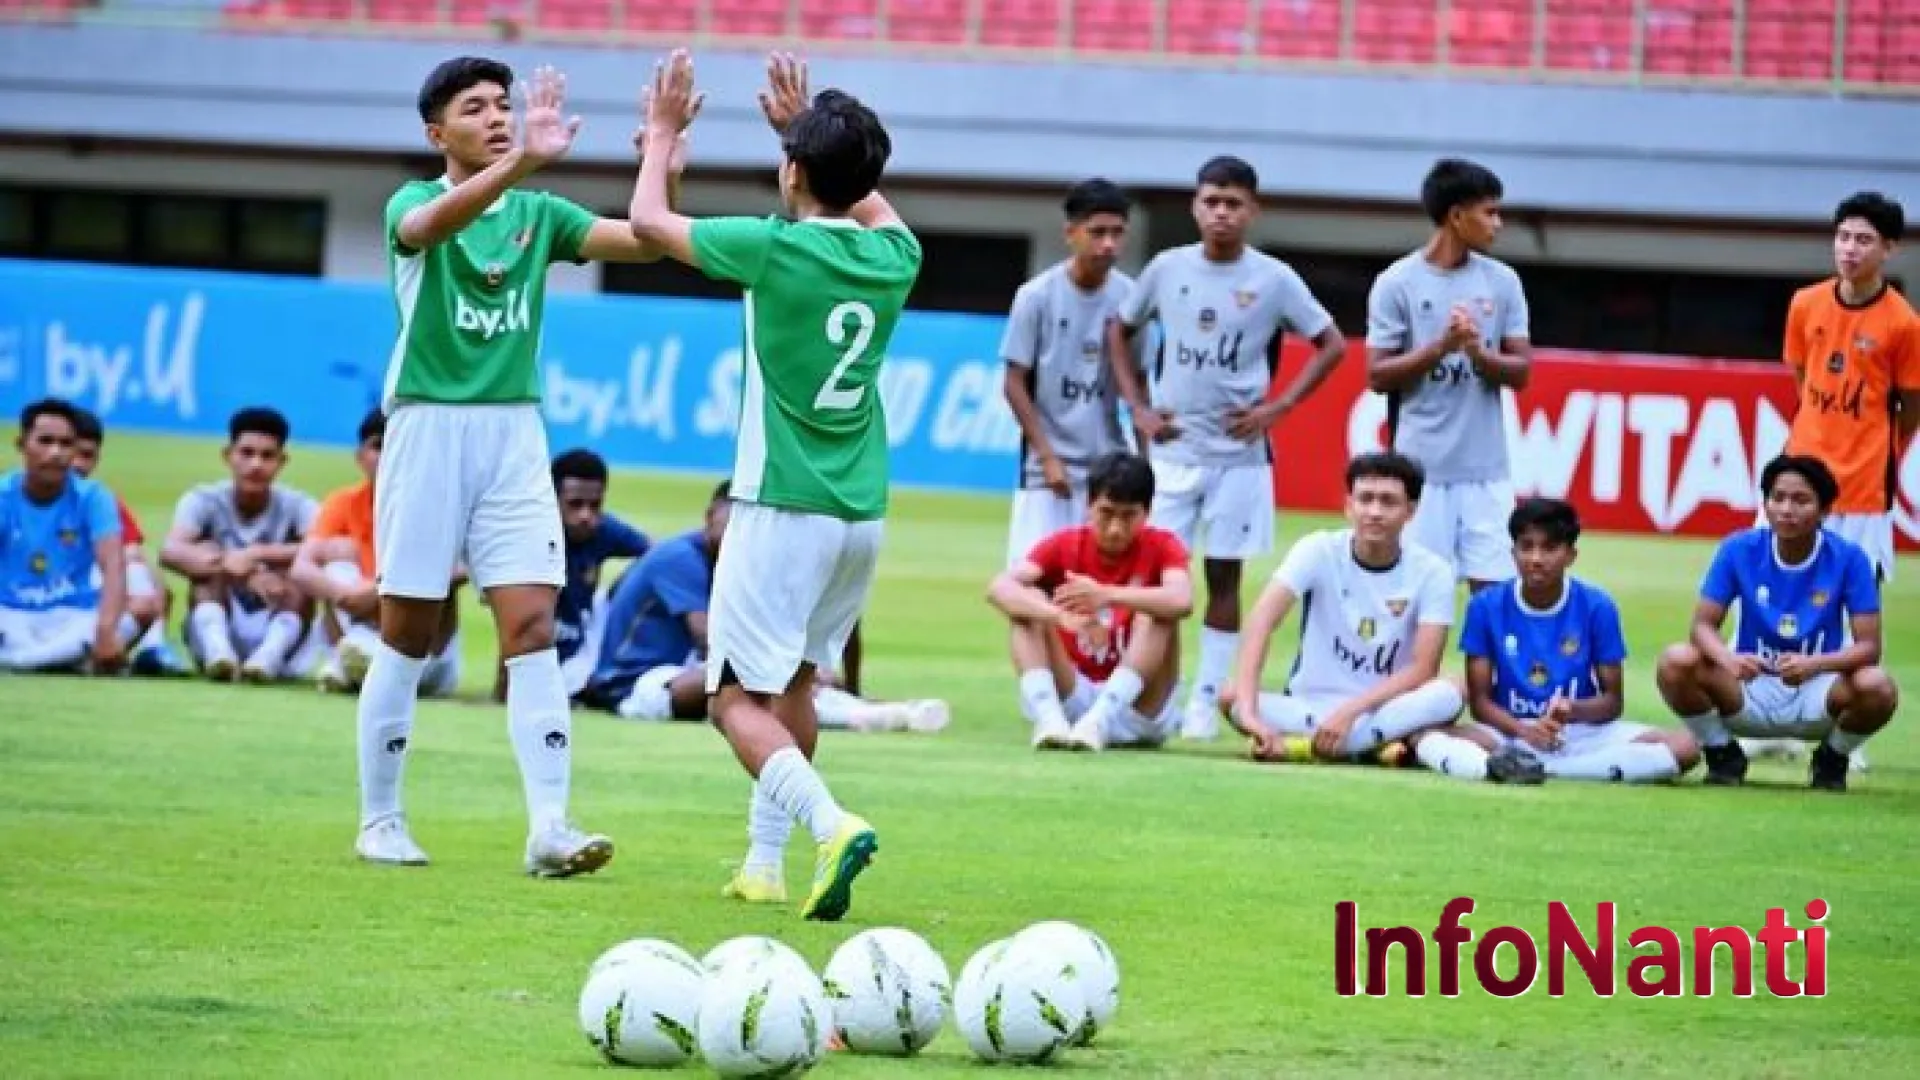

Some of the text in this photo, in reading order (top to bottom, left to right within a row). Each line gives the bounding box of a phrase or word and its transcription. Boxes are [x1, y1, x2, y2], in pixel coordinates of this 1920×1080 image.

[46, 292, 206, 420] by.U
[455, 282, 530, 340] by.U
[813, 301, 876, 410] 2
[1177, 331, 1244, 373] by.U
[545, 335, 682, 442] by.U
